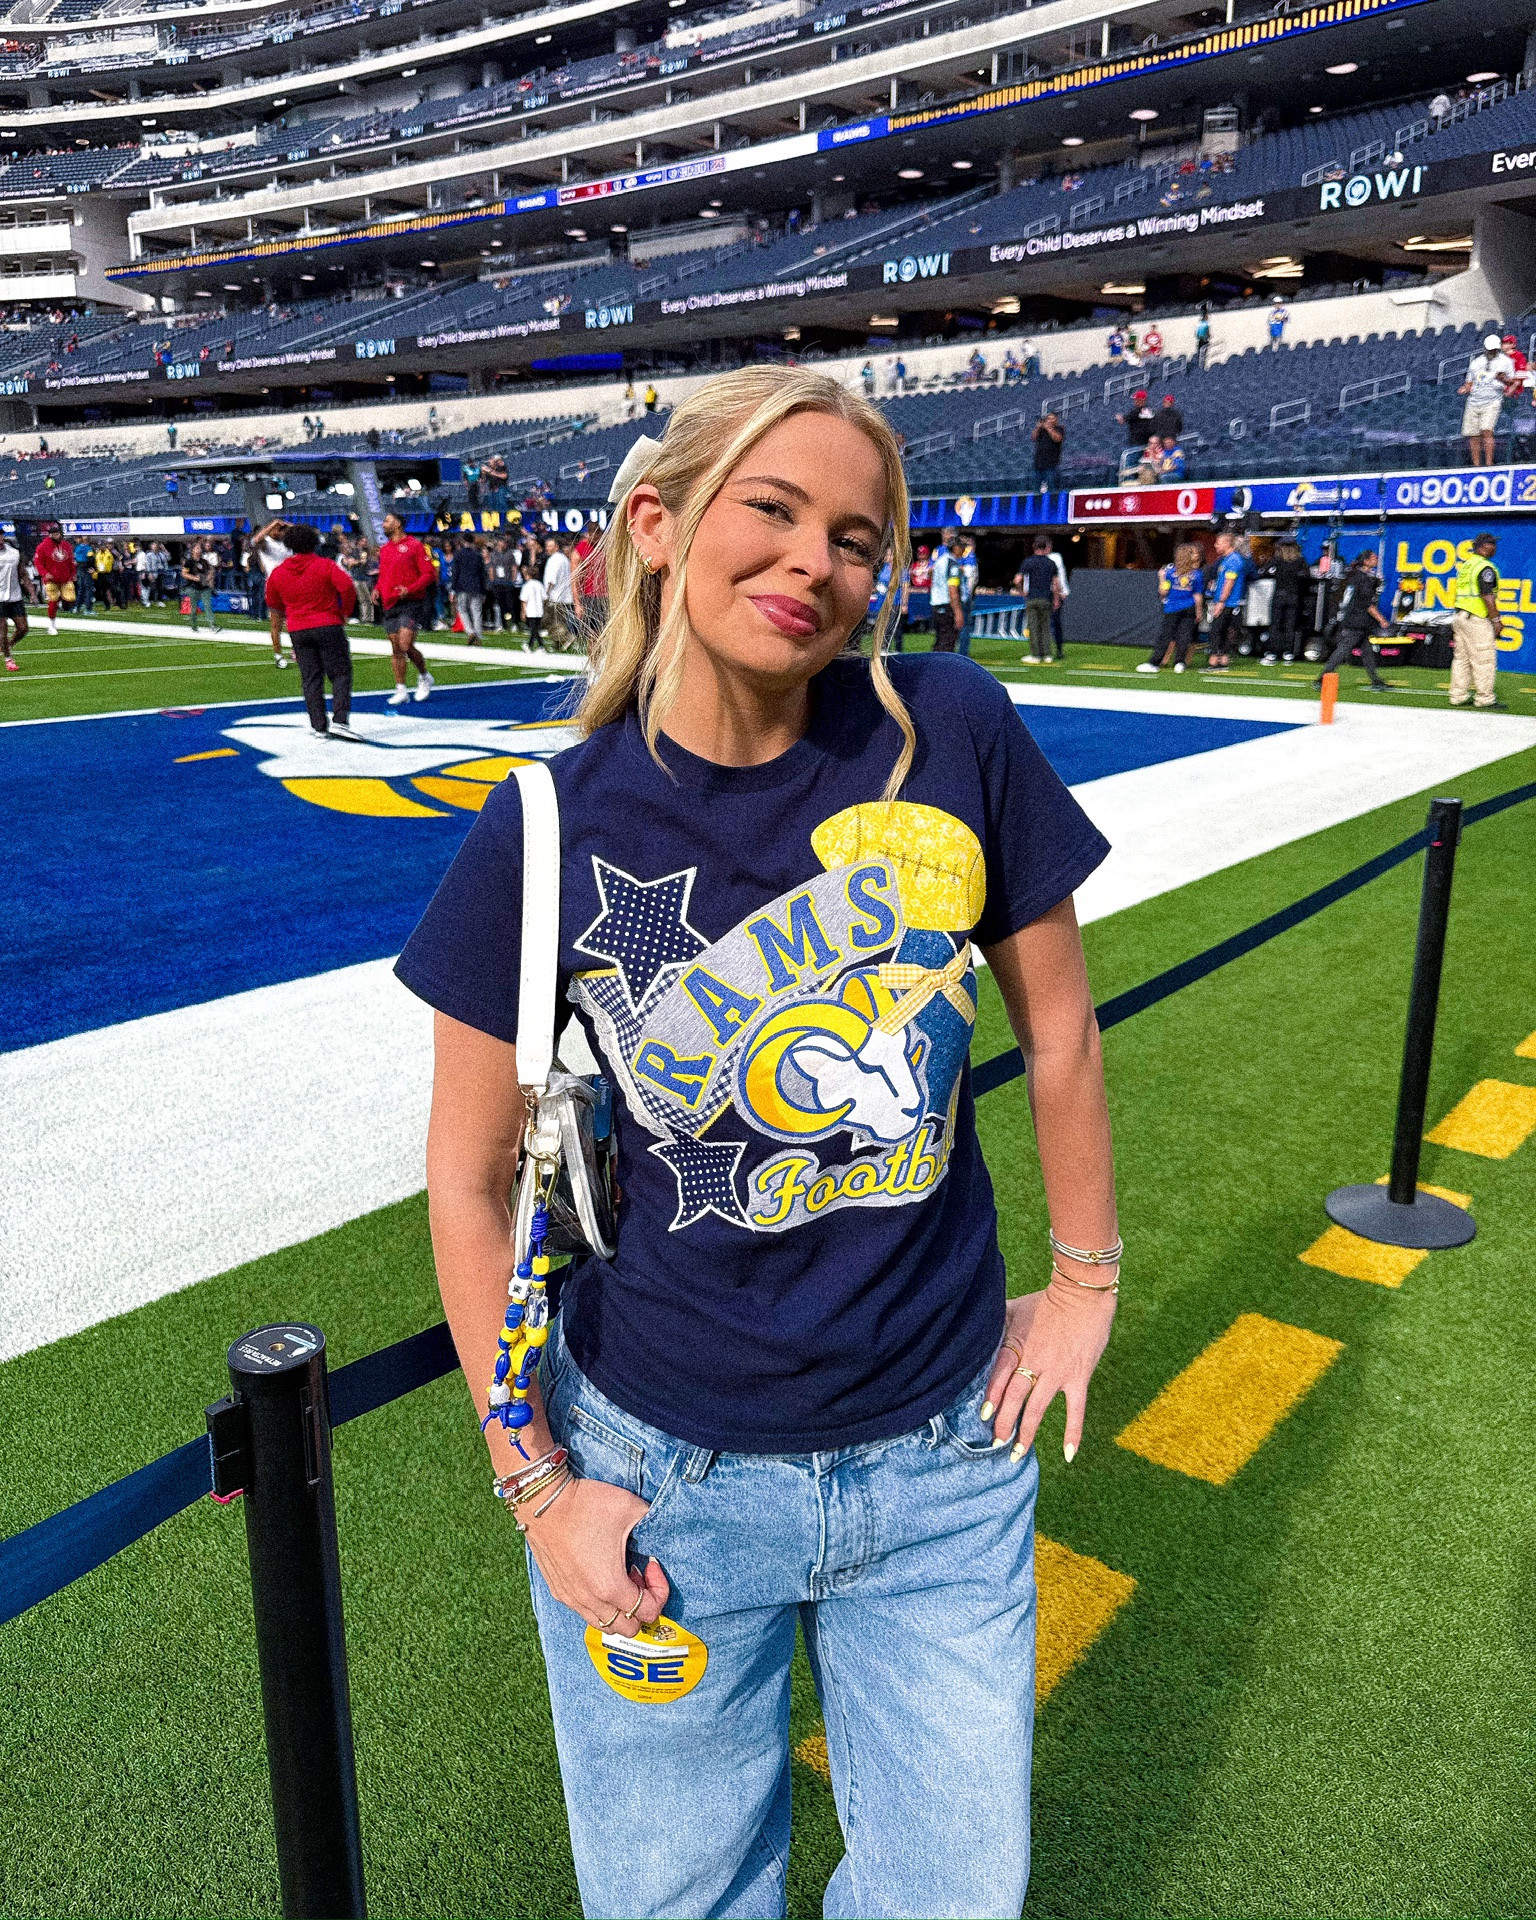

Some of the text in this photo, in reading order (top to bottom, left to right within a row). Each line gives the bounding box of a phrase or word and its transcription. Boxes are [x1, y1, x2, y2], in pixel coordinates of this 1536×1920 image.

[1492, 151, 1536, 173] Ever
[1320, 166, 1423, 211] ROWI
[990, 199, 1265, 262] Every Child Deserves a Winning Mindset
[883, 252, 949, 283] ROWI
[661, 299, 687, 314] Every
[764, 281, 805, 298] Winning
[585, 304, 633, 328] ROWI
[355, 339, 395, 358] ROWI
[1177, 489, 1197, 515] 0
[1421, 474, 1508, 505] 90:00
[632, 863, 899, 1110] RAMS
[752, 1115, 954, 1227] Footb
[607, 1652, 684, 1683] SE
